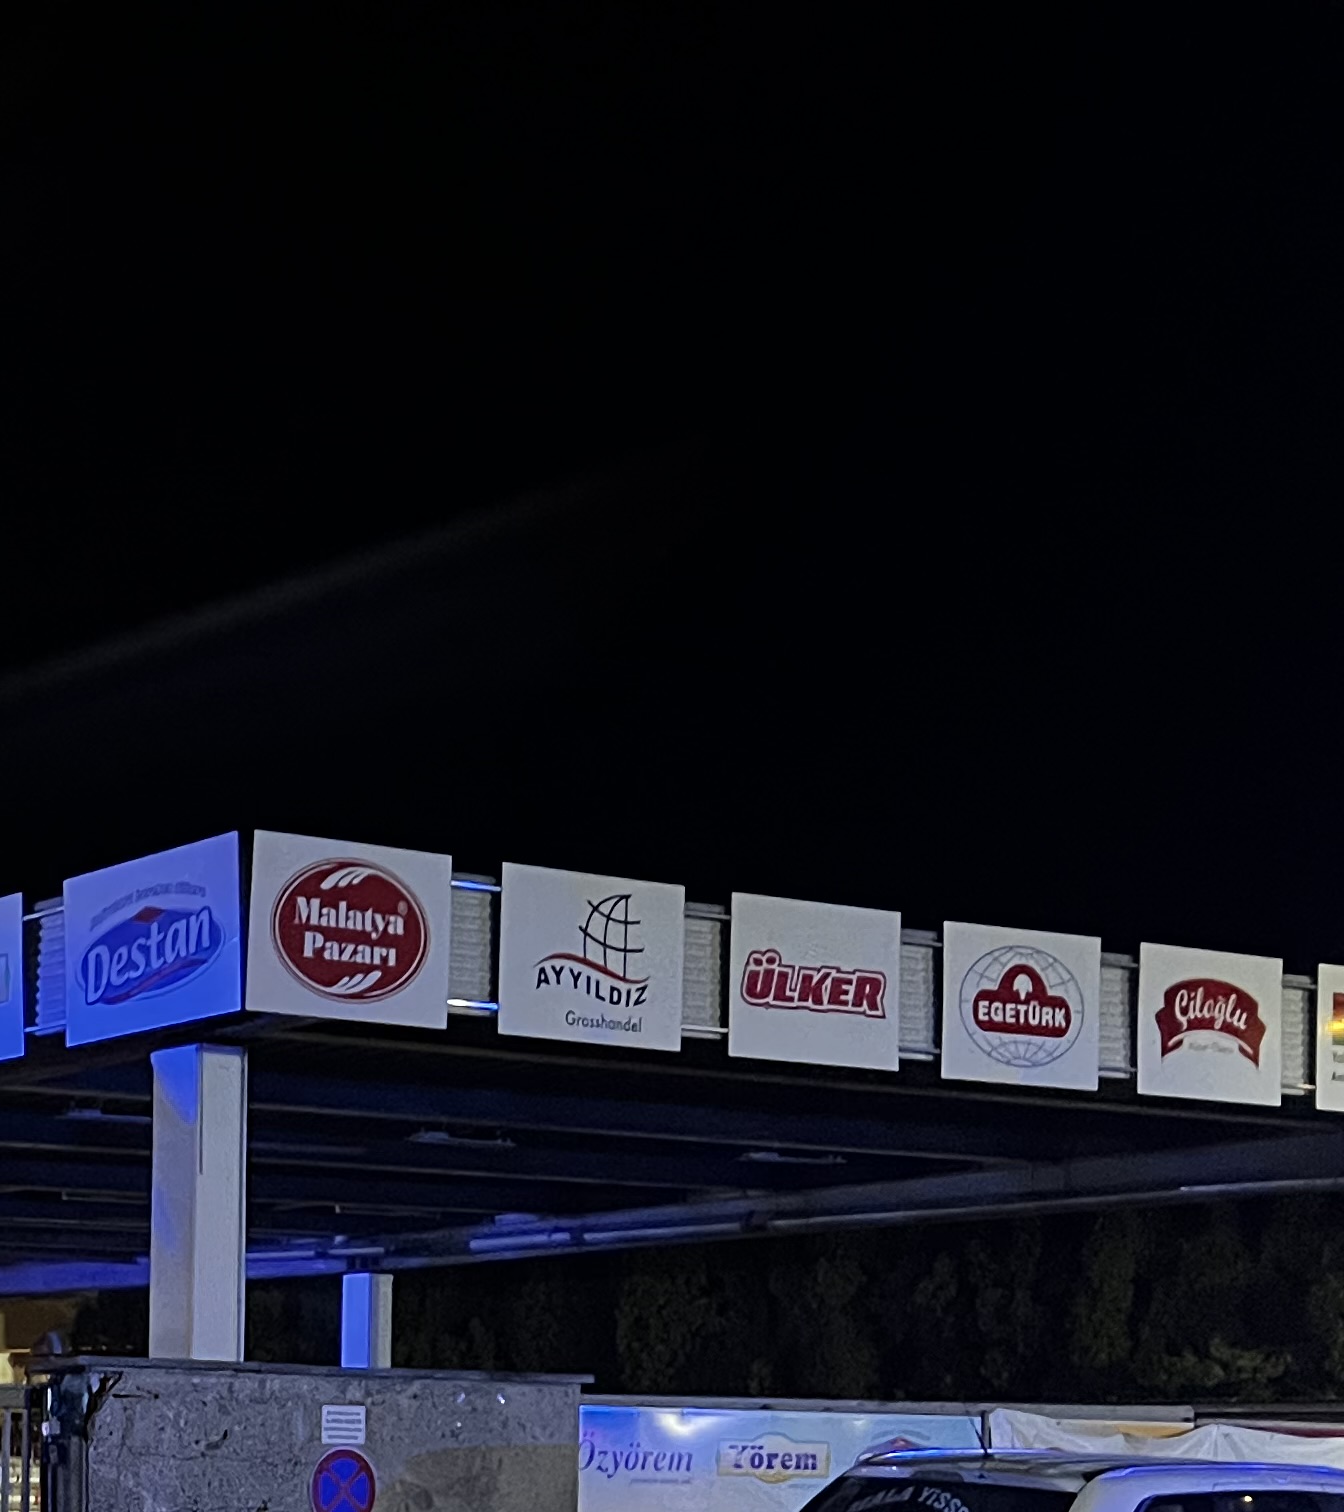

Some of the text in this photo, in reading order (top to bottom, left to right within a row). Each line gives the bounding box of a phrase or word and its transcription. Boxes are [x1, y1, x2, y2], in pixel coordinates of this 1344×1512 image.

[294, 896, 405, 940] Malatya
[85, 906, 212, 1006] Destan
[303, 931, 397, 967] Pazarı
[535, 965, 649, 1008] AYYILDIZ
[742, 951, 885, 1015] ÜLKER
[565, 1009, 643, 1033] Grosshandel
[978, 1000, 1067, 1029] EGETÜRK
[1174, 986, 1248, 1031] Çiloğlu
[728, 1444, 817, 1471] Yörem
